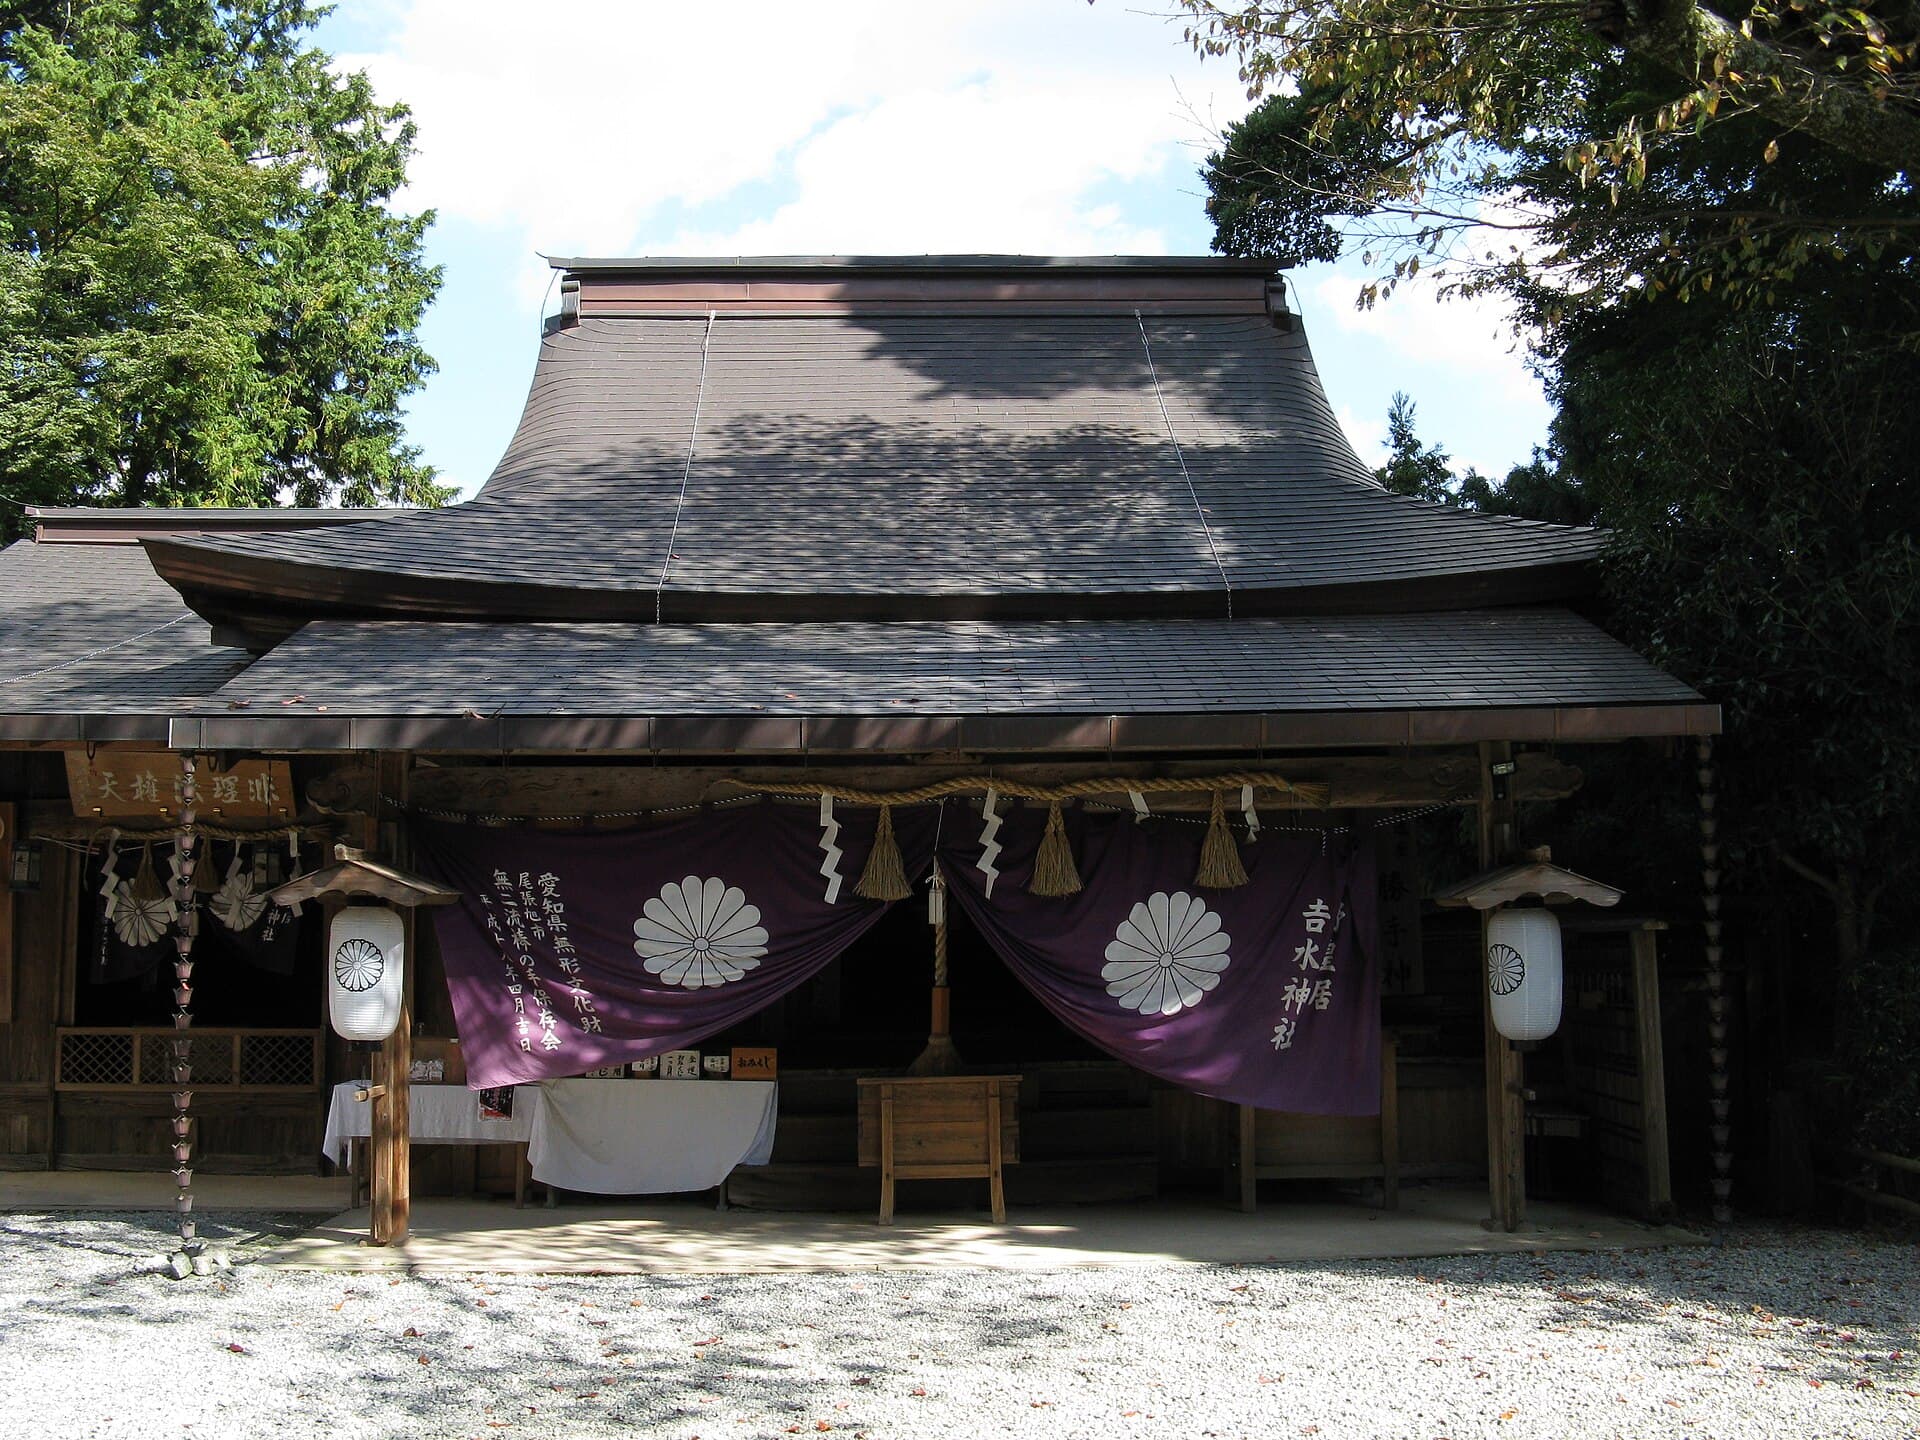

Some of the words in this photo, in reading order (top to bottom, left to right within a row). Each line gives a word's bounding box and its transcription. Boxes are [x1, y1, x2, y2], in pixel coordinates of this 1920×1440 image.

[493, 868, 562, 1051] 無二流棒の手保存会
[518, 871, 546, 941] 尾張旭市
[537, 871, 602, 1034] 愛知県無形文化財
[1271, 898, 1331, 1051] 吉水神社
